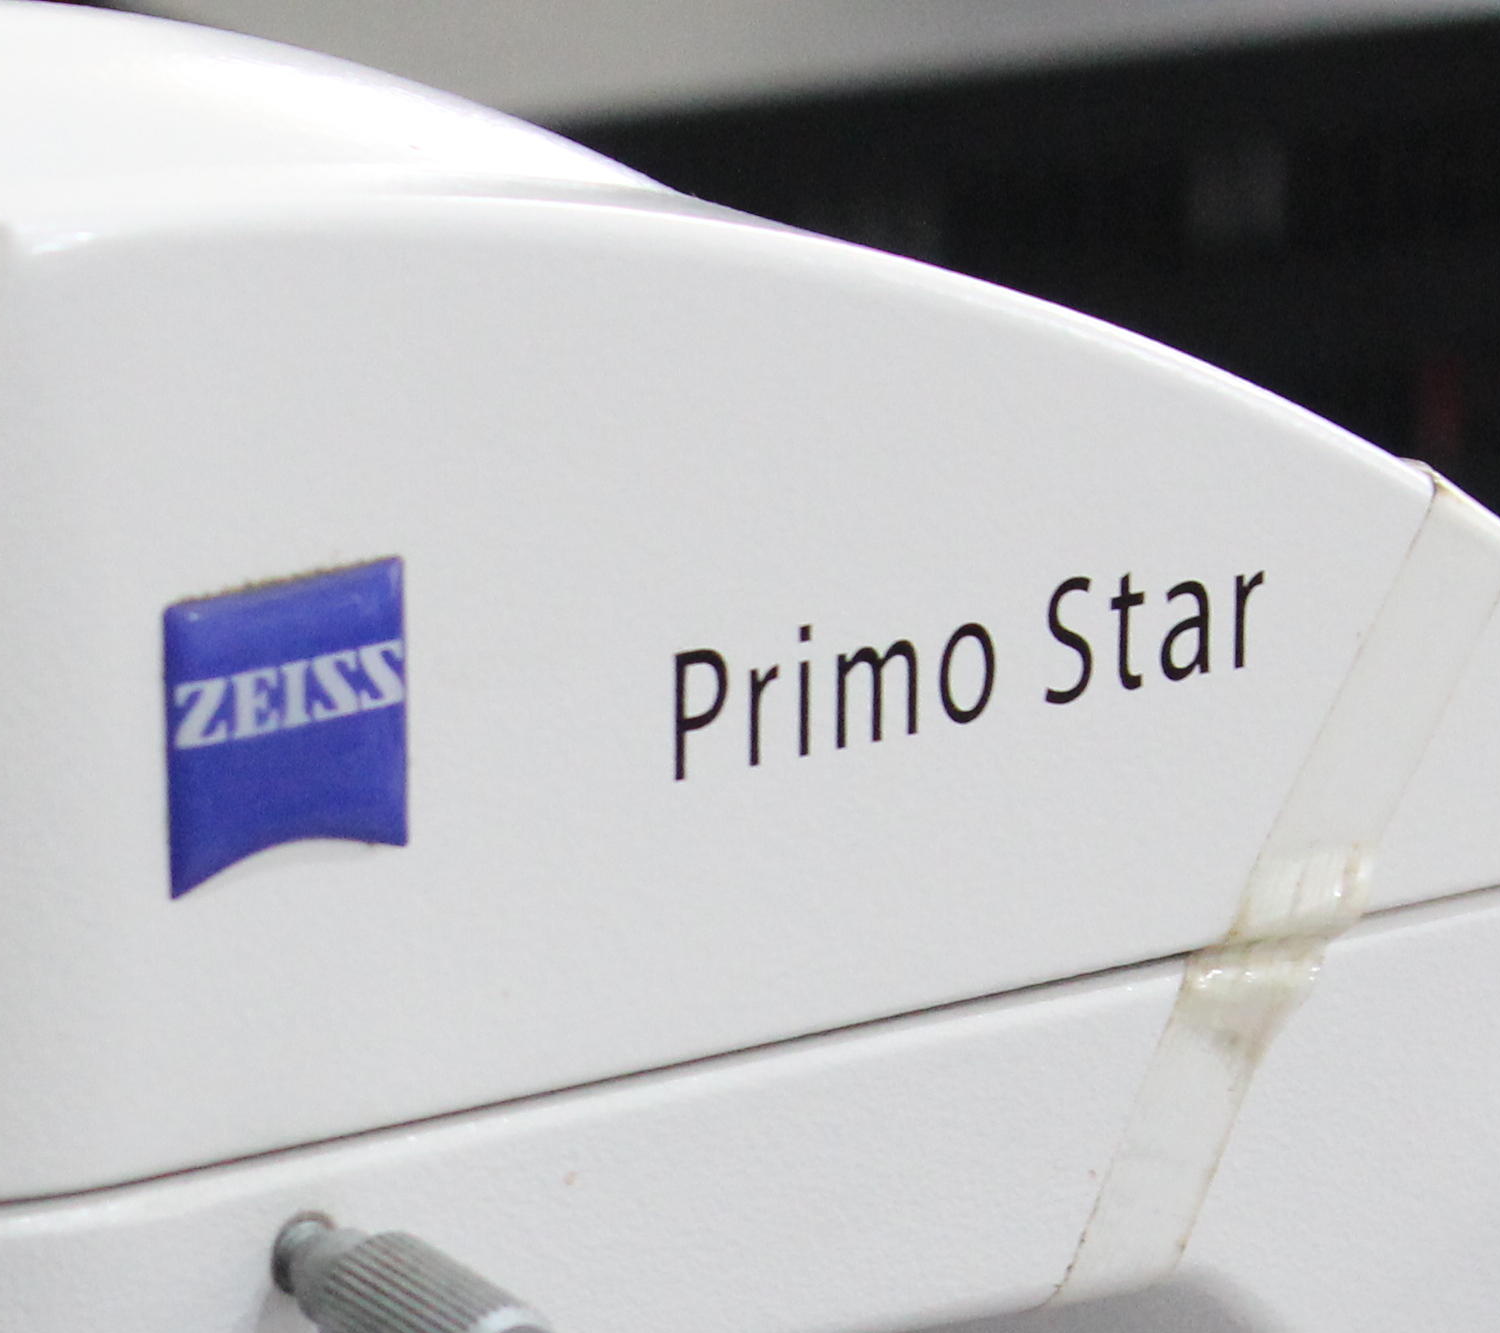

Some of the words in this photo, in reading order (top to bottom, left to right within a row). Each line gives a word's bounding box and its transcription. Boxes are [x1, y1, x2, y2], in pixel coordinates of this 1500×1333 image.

[173, 638, 404, 749] ZEISS
[672, 624, 998, 781] Primo
[1044, 570, 1267, 707] Star
